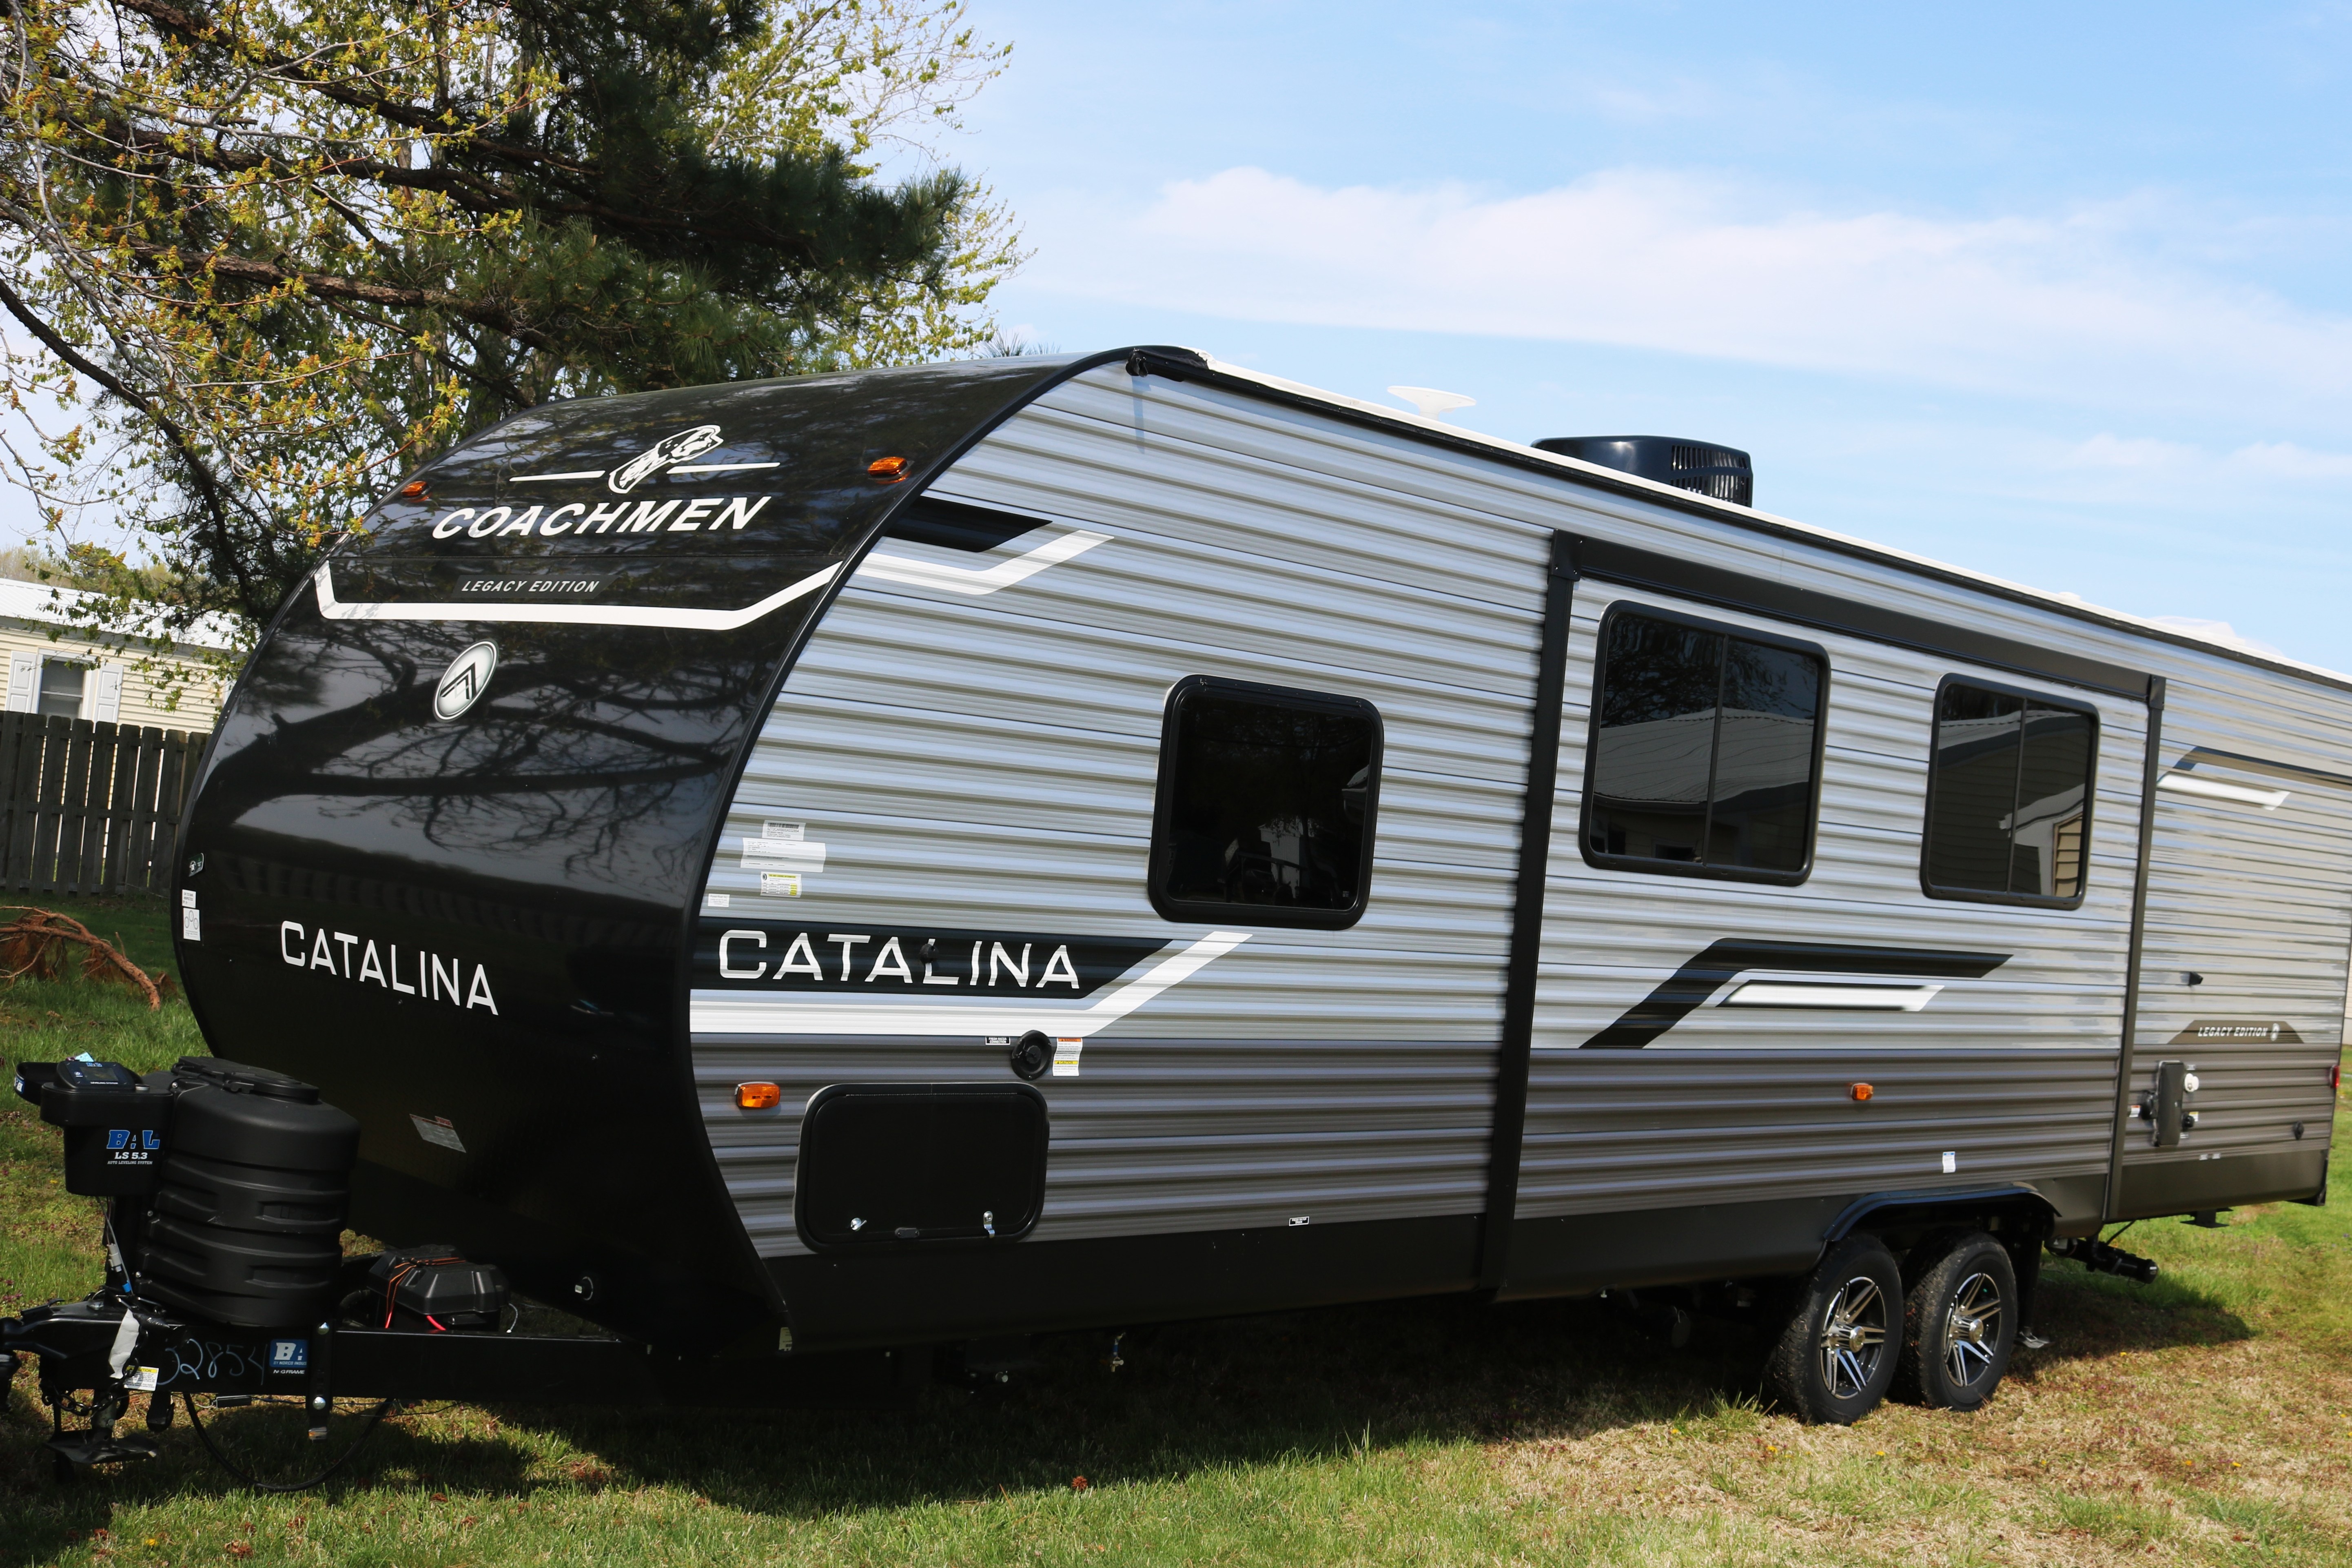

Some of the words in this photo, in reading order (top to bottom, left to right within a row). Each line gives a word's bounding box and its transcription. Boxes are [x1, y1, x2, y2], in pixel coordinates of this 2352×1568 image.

[432, 496, 771, 539] COACHMEN
[461, 581, 527, 592] LEGACY
[528, 581, 600, 592] EDITION
[282, 920, 499, 1016] CATALINA
[719, 929, 1080, 989] CATALINA
[2197, 1027, 2232, 1037] LEGACY
[2234, 1027, 2268, 1037] EDITION
[106, 1129, 160, 1149] BAL
[115, 1151, 129, 1160] LS
